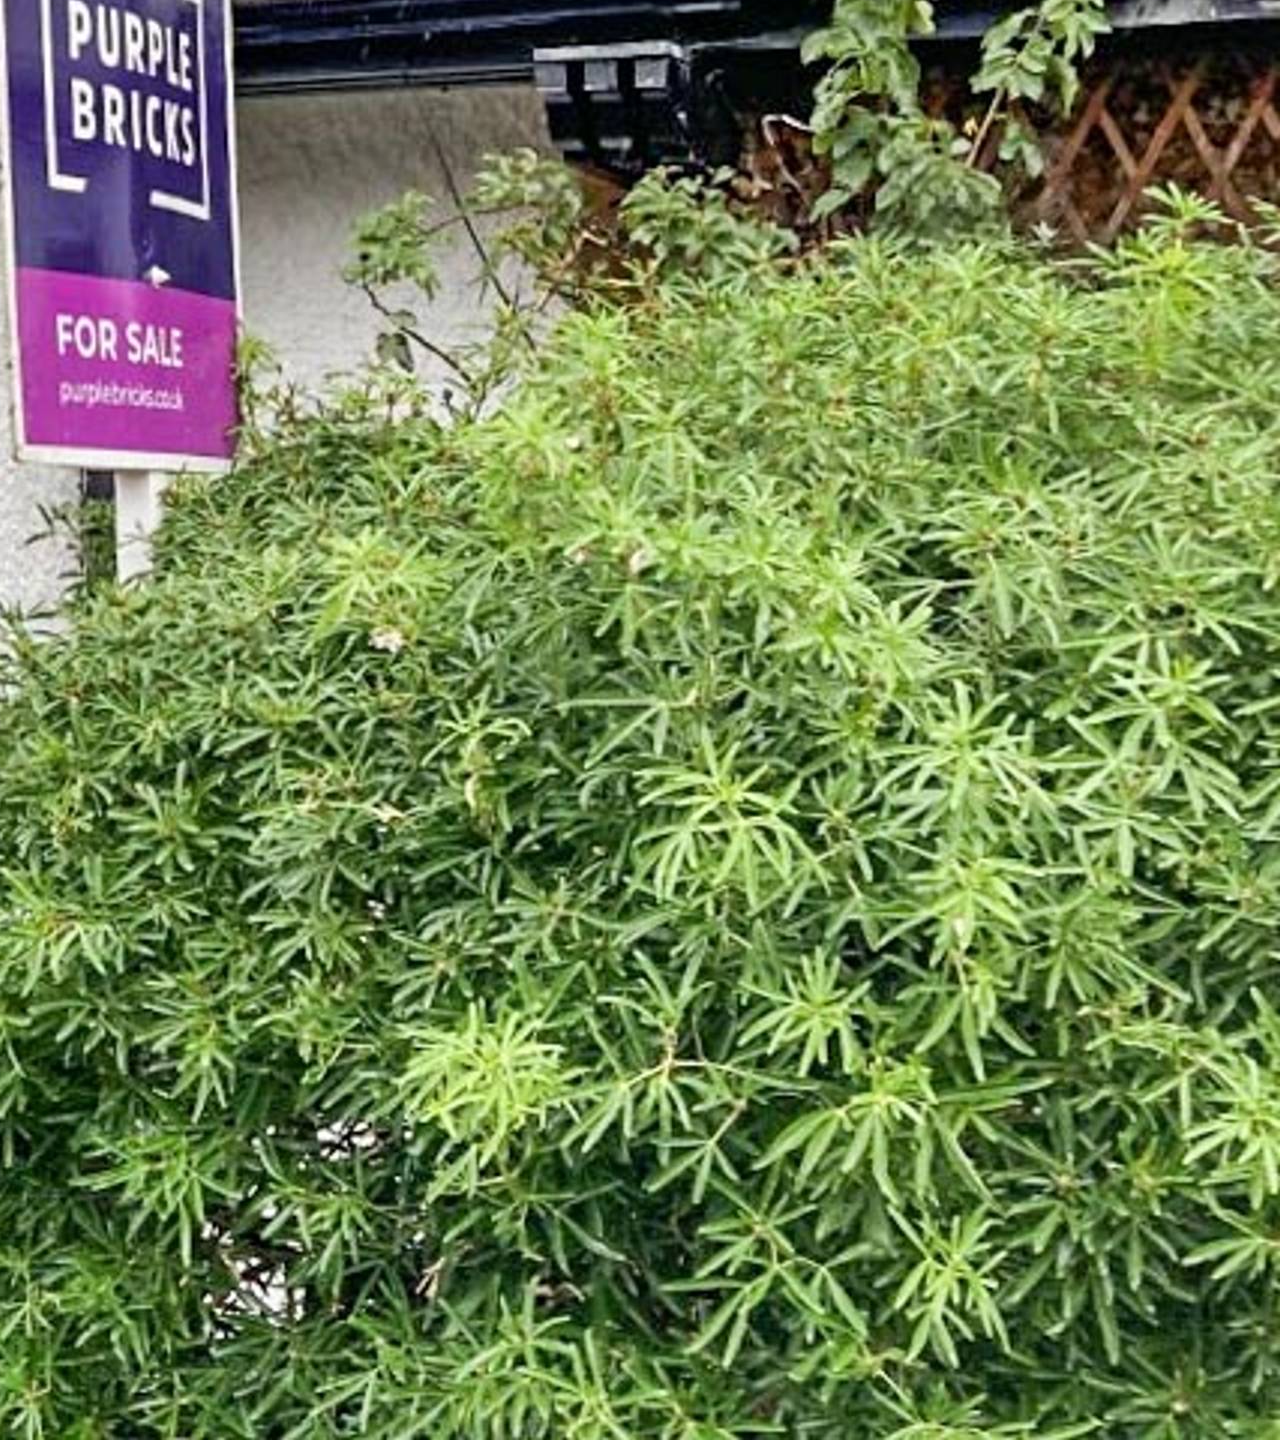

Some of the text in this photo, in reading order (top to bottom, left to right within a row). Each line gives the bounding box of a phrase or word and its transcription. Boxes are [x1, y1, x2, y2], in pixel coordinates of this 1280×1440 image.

[71, 77, 195, 167] BRICKS
[56, 314, 184, 368] FOR SALE
